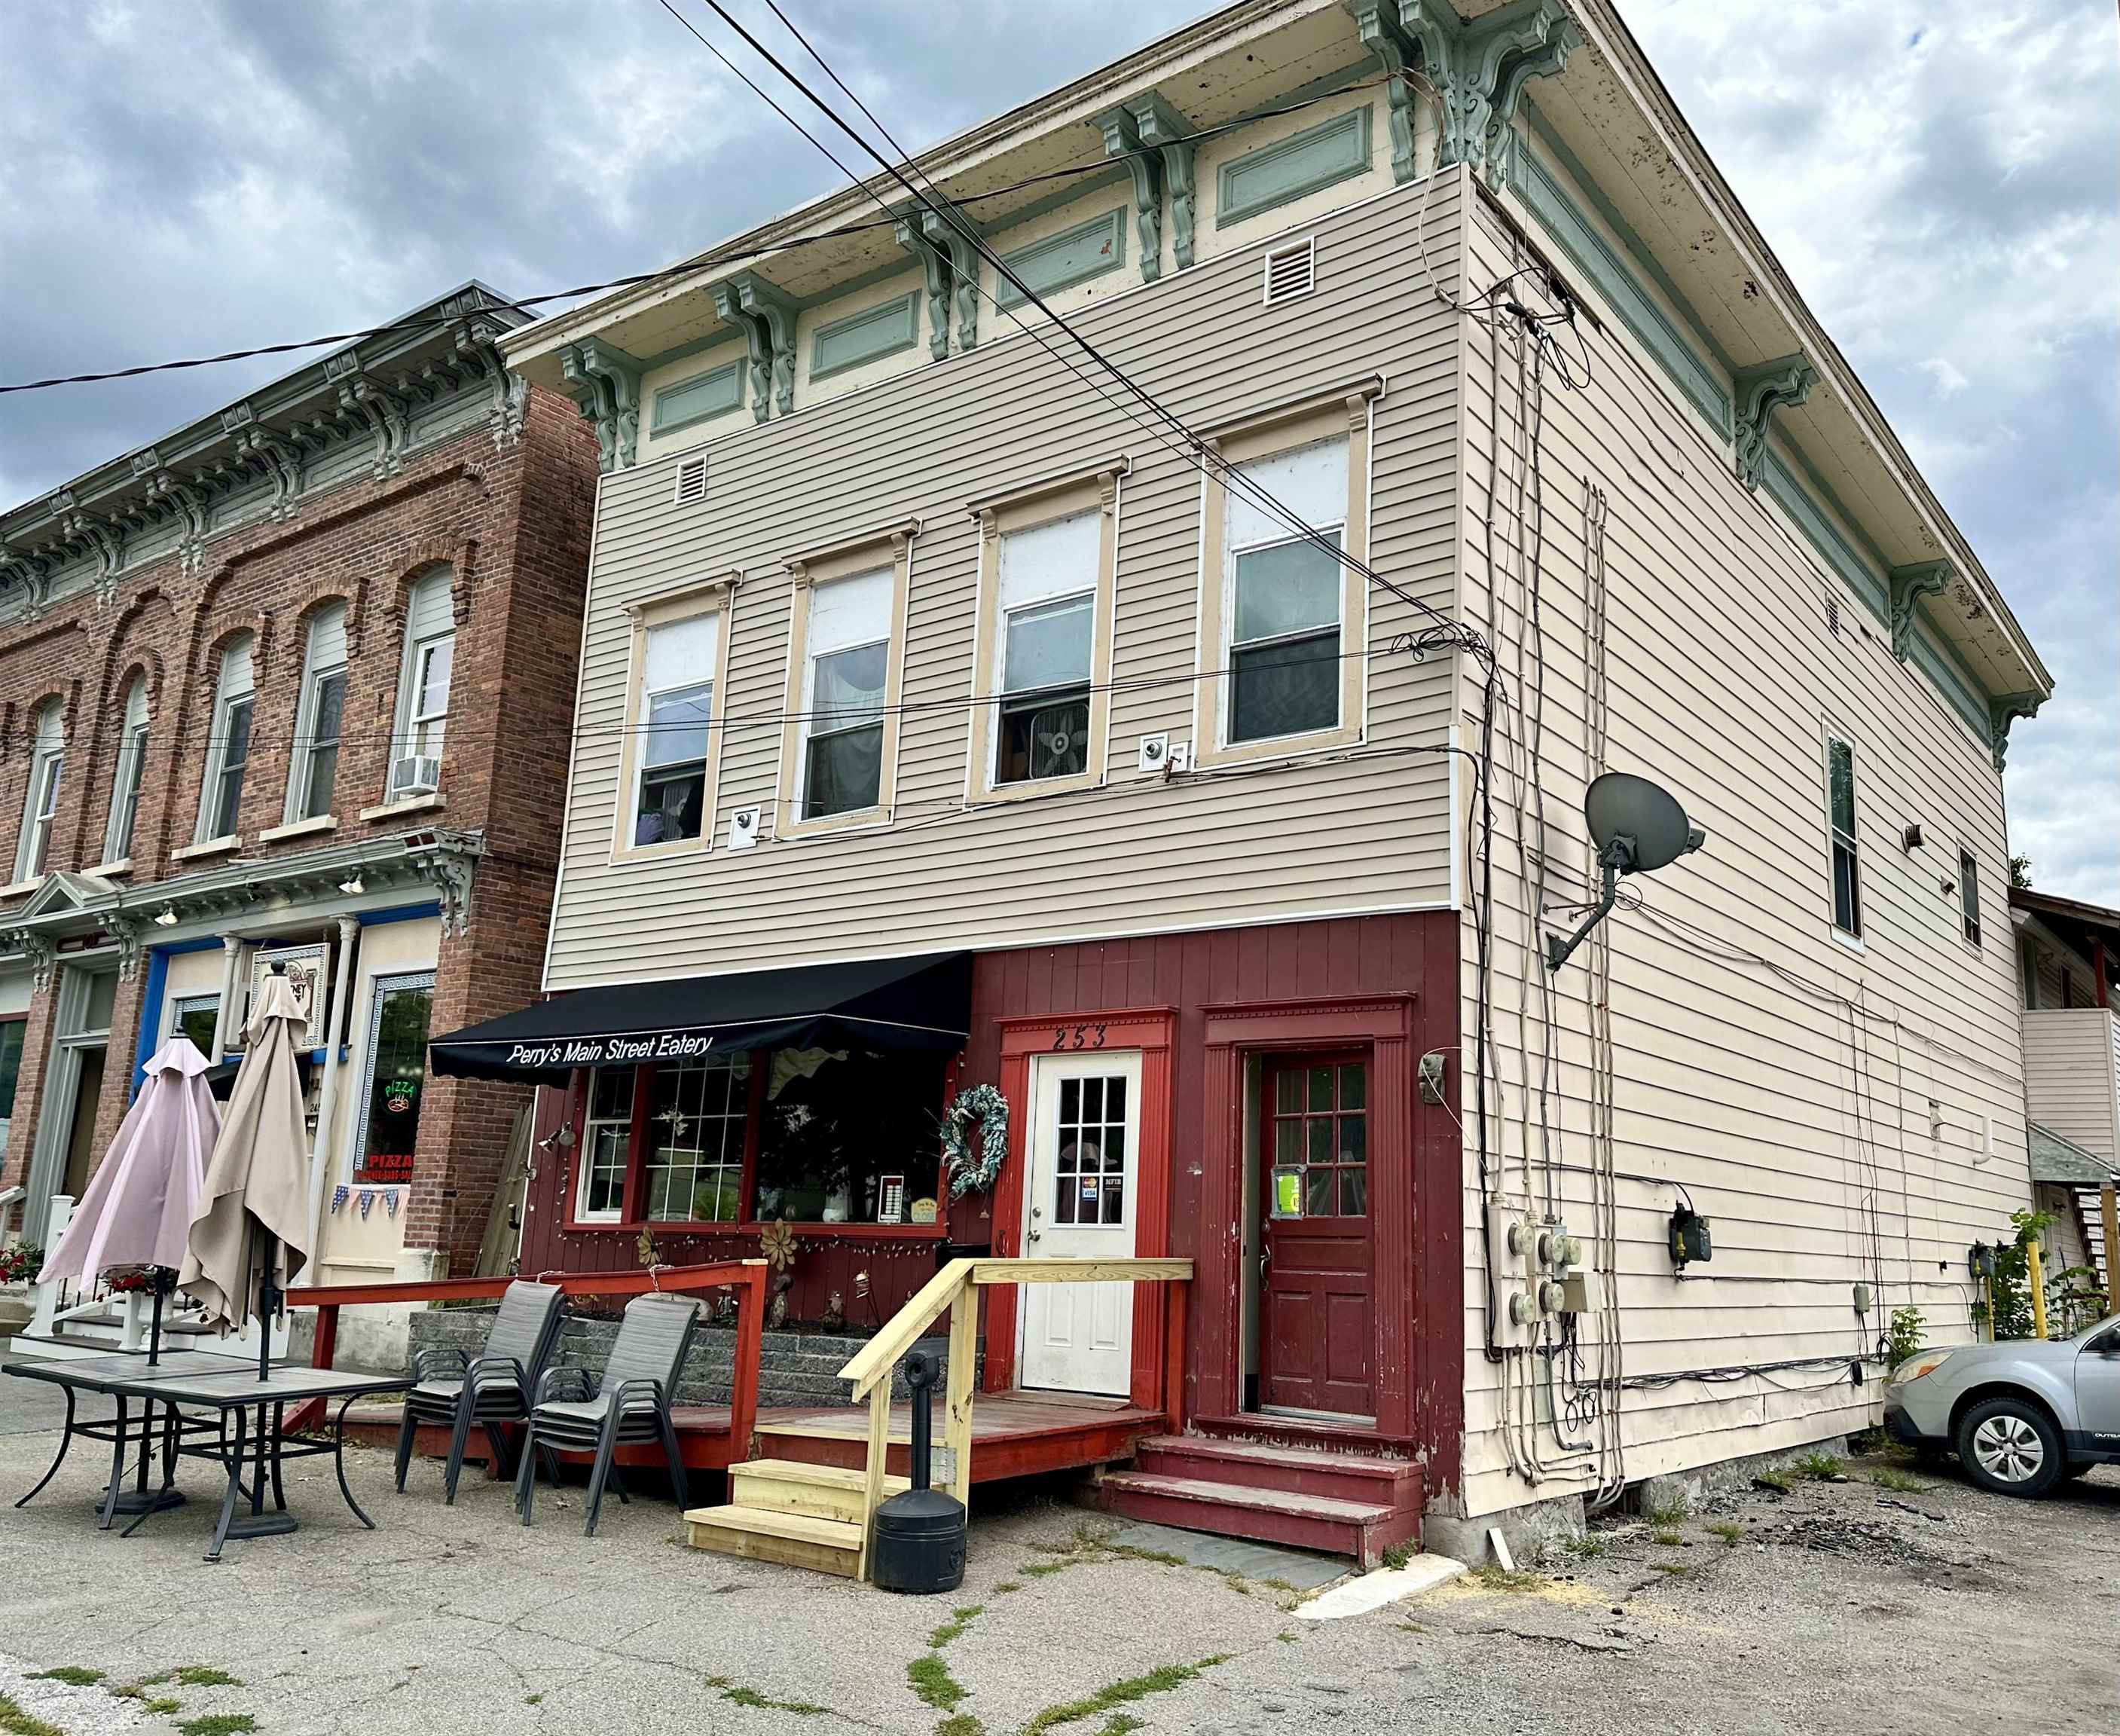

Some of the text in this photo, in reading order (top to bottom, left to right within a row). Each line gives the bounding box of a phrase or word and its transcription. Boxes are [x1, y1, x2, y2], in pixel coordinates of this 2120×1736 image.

[1053, 1025, 1107, 1049] 253
[506, 1034, 713, 1067] Perry's Main Street Eatery
[385, 1079, 414, 1098] PIZZA
[368, 1154, 412, 1168] PIZZA
